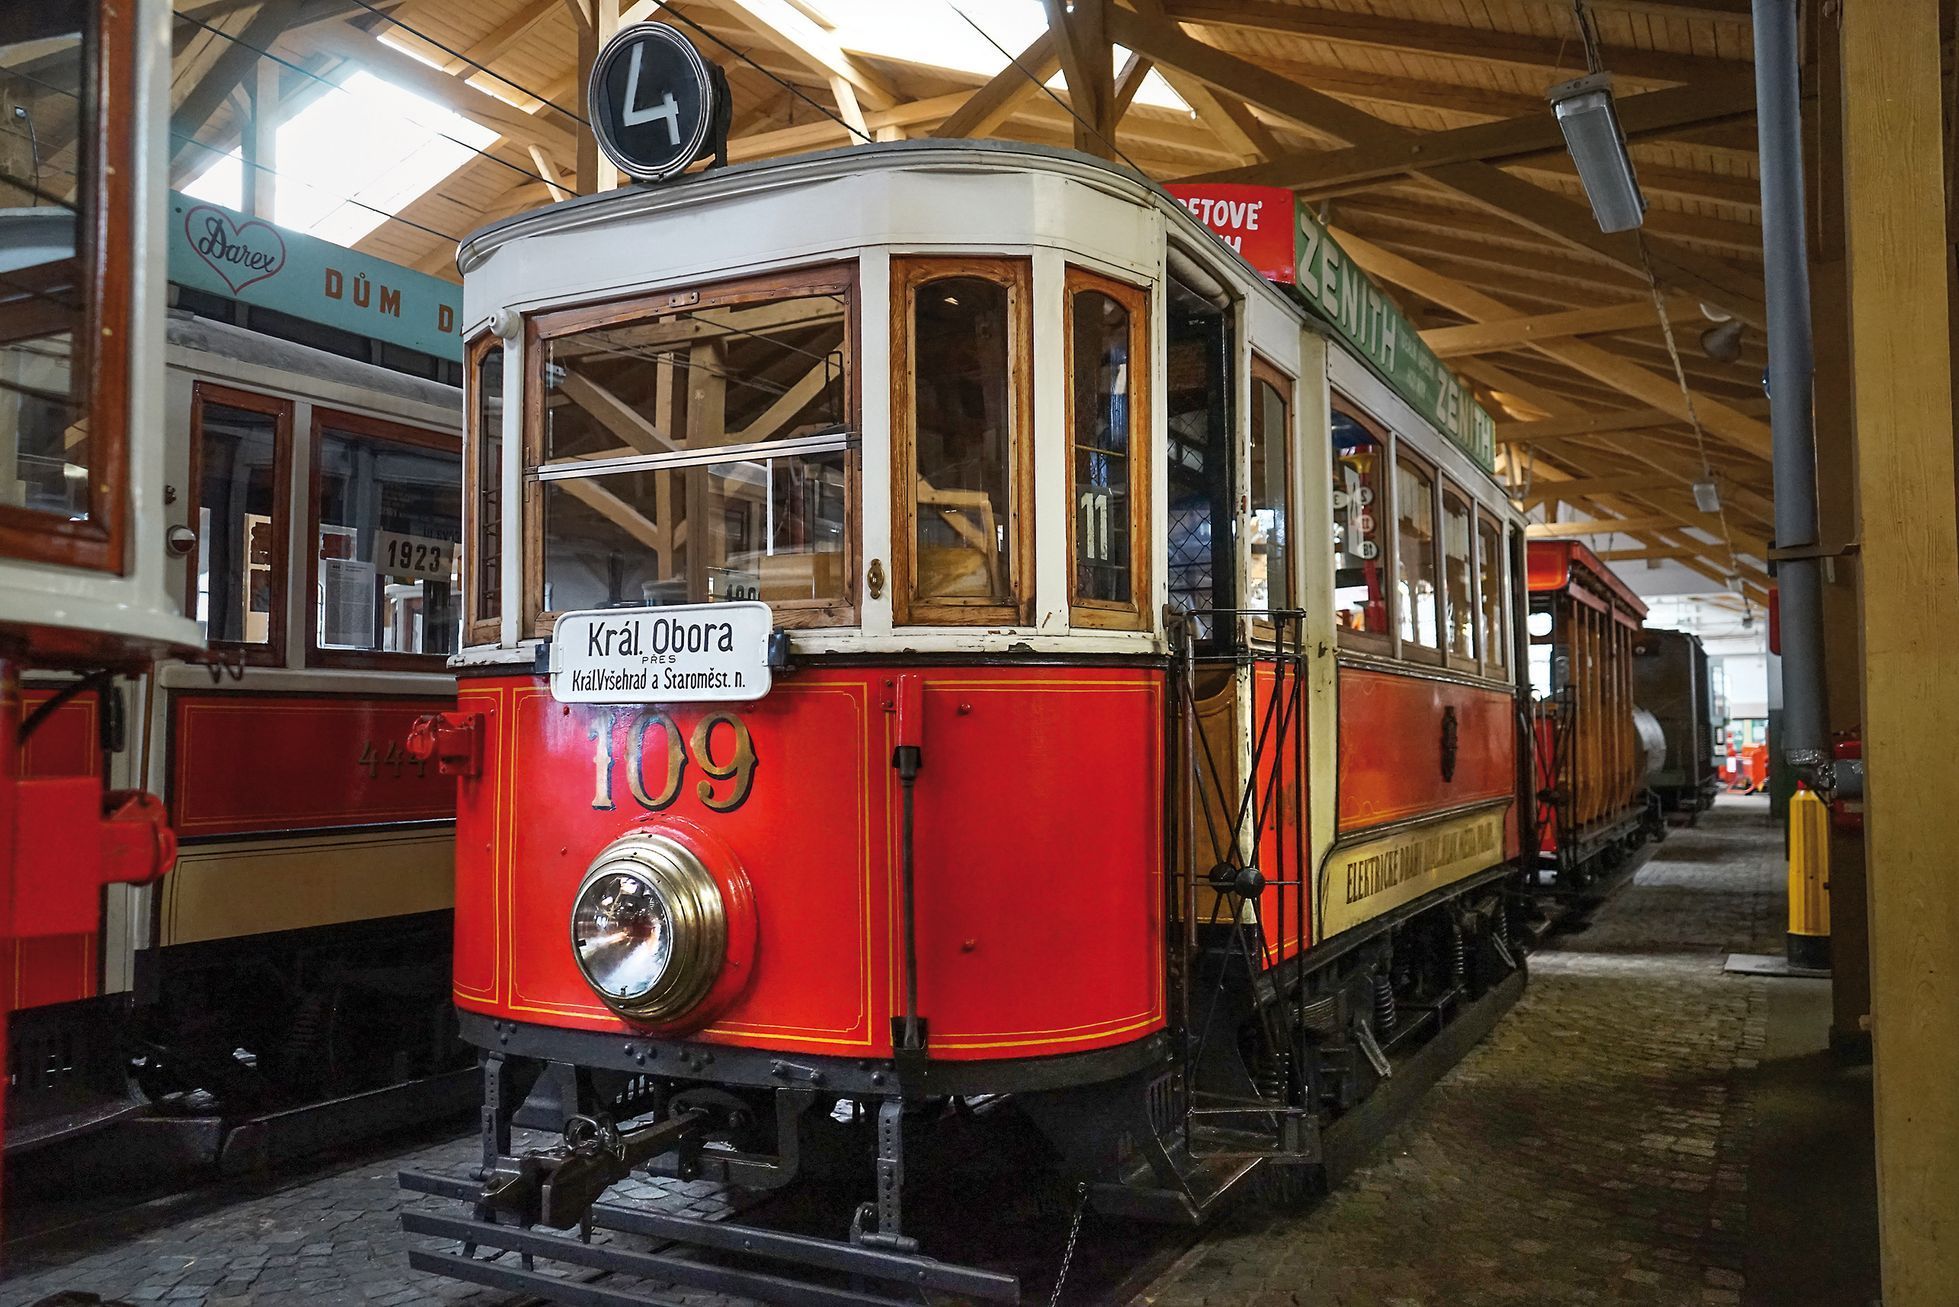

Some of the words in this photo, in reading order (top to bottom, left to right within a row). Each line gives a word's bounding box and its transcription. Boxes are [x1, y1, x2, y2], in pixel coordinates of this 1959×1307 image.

[623, 42, 680, 145] 4
[199, 216, 275, 273] Darex
[325, 267, 400, 318] DŮM
[438, 303, 465, 337] D
[1300, 212, 1398, 373] ZENITH
[1435, 367, 1492, 466] ZENITH
[387, 540, 441, 573] 1923
[1081, 492, 1108, 560] 11
[588, 621, 643, 657] Král.
[652, 618, 734, 655] Obora
[641, 653, 677, 665] PŘES
[651, 673, 659, 690] a
[663, 667, 732, 690] Staroměst.
[734, 670, 746, 689] n.
[588, 710, 760, 813] 109
